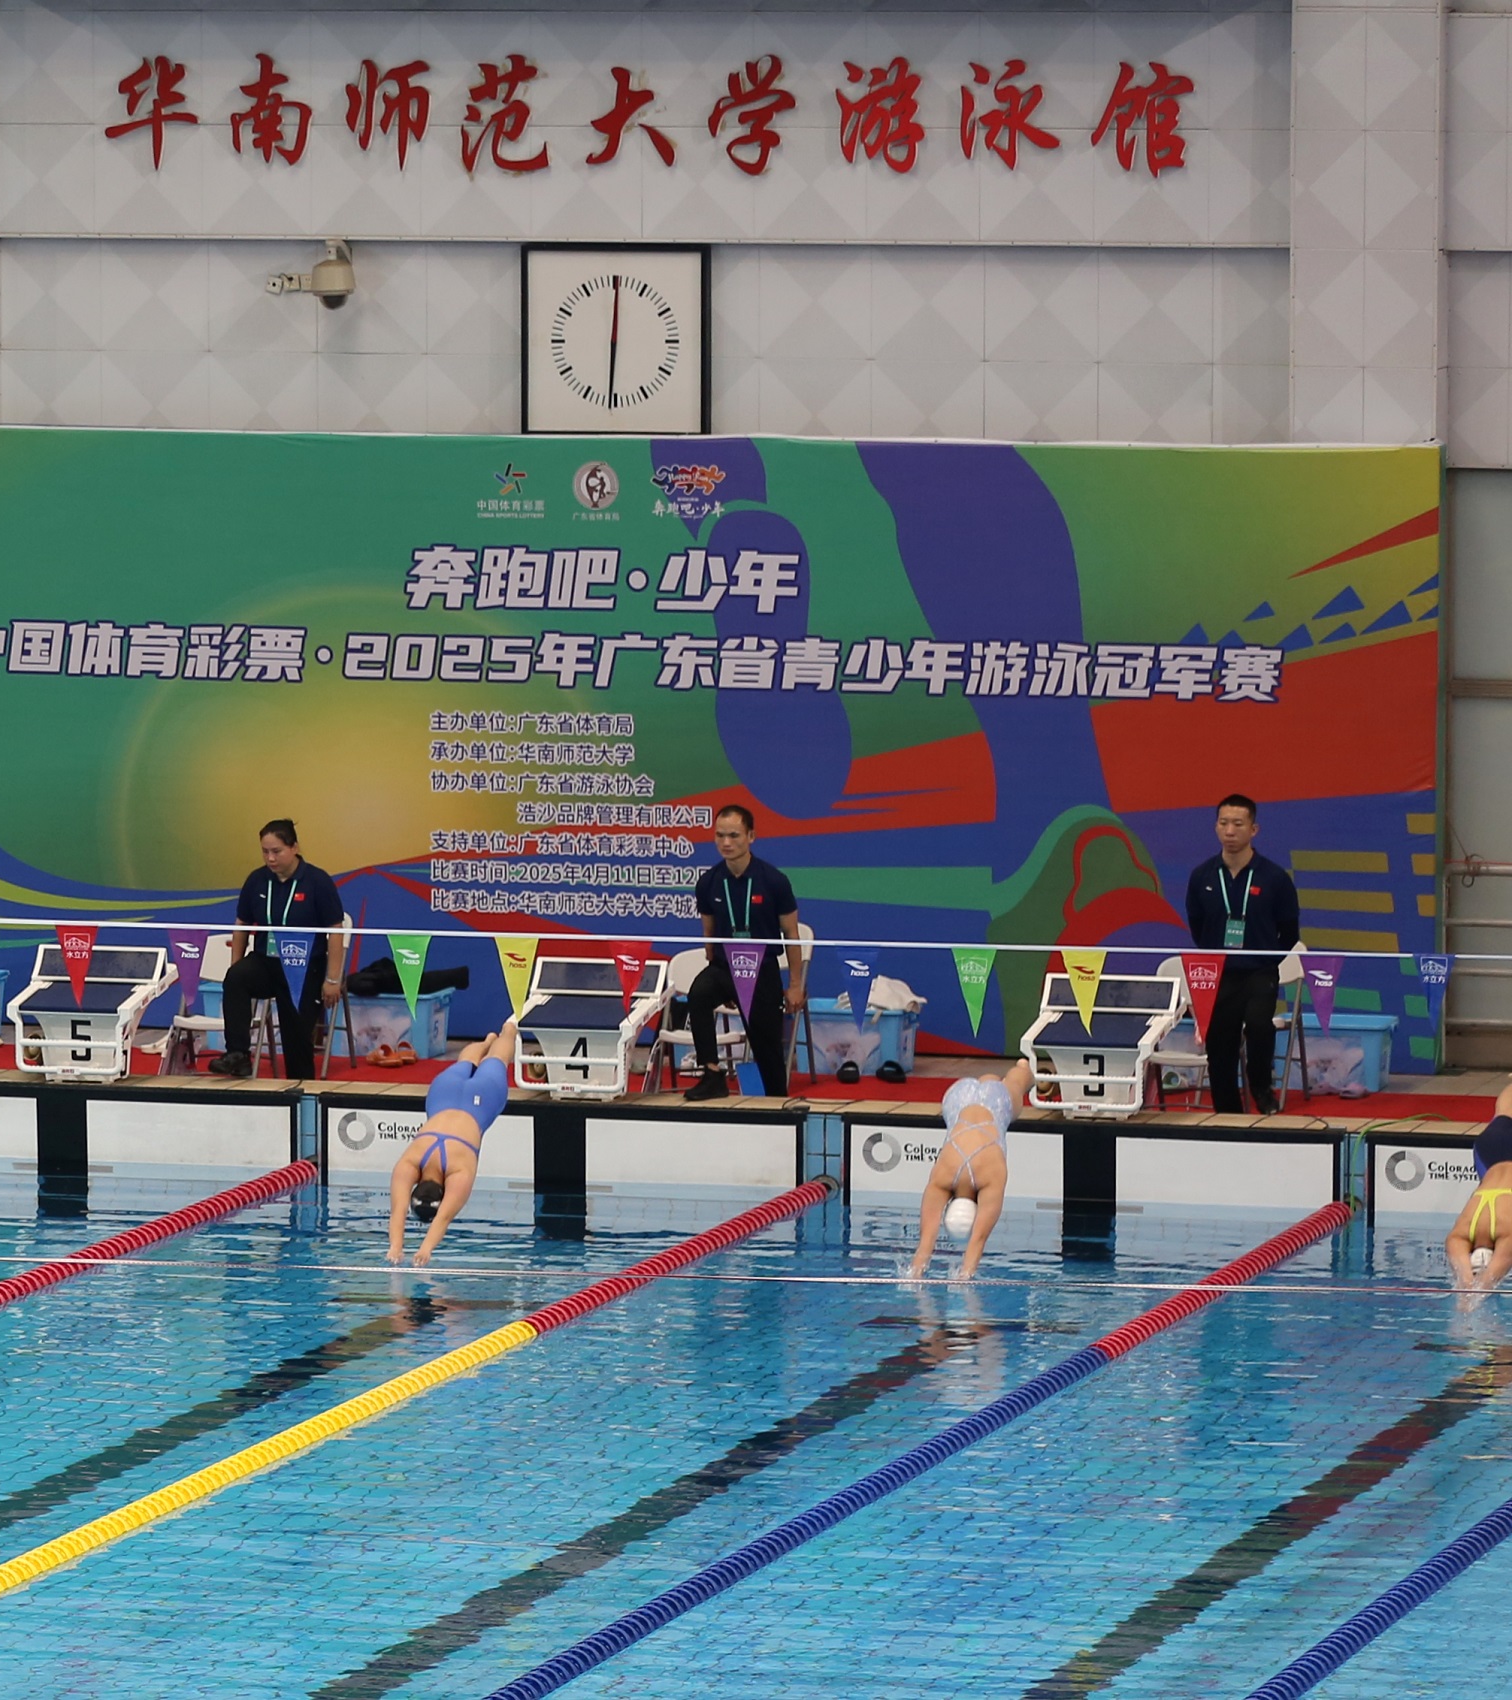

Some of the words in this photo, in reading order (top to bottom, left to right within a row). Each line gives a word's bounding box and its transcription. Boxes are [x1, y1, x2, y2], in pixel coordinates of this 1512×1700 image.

[103, 54, 1196, 177] 华南师范大学游泳馆
[476, 499, 545, 511] 中国体育彩票
[405, 544, 801, 614] 奔跑吧·少年
[517, 802, 713, 829] 浩沙品牌管理有限公司
[430, 859, 710, 888] 比赛时间：2025年4月11日至12
[66, 950, 89, 959] 水立方
[181, 951, 200, 959] hosa
[283, 957, 306, 966] 水立方
[402, 957, 421, 965] hosa
[508, 961, 527, 969] hosa
[622, 964, 640, 972] hosa
[733, 969, 756, 979] 水立方
[850, 969, 870, 977] hosa
[962, 975, 986, 984] 水立方
[1314, 979, 1333, 987] hosa
[1422, 975, 1446, 984] 水立方
[1190, 981, 1216, 990] 水立方
[70, 1019, 92, 1062] 5
[565, 1036, 590, 1080] 4
[1082, 1053, 1105, 1097] 3
[379, 1132, 398, 1140] TIME
[905, 1154, 924, 1162] TIME
[1429, 1172, 1449, 1181] TIME
[1453, 1173, 1478, 1183] SYSTE
